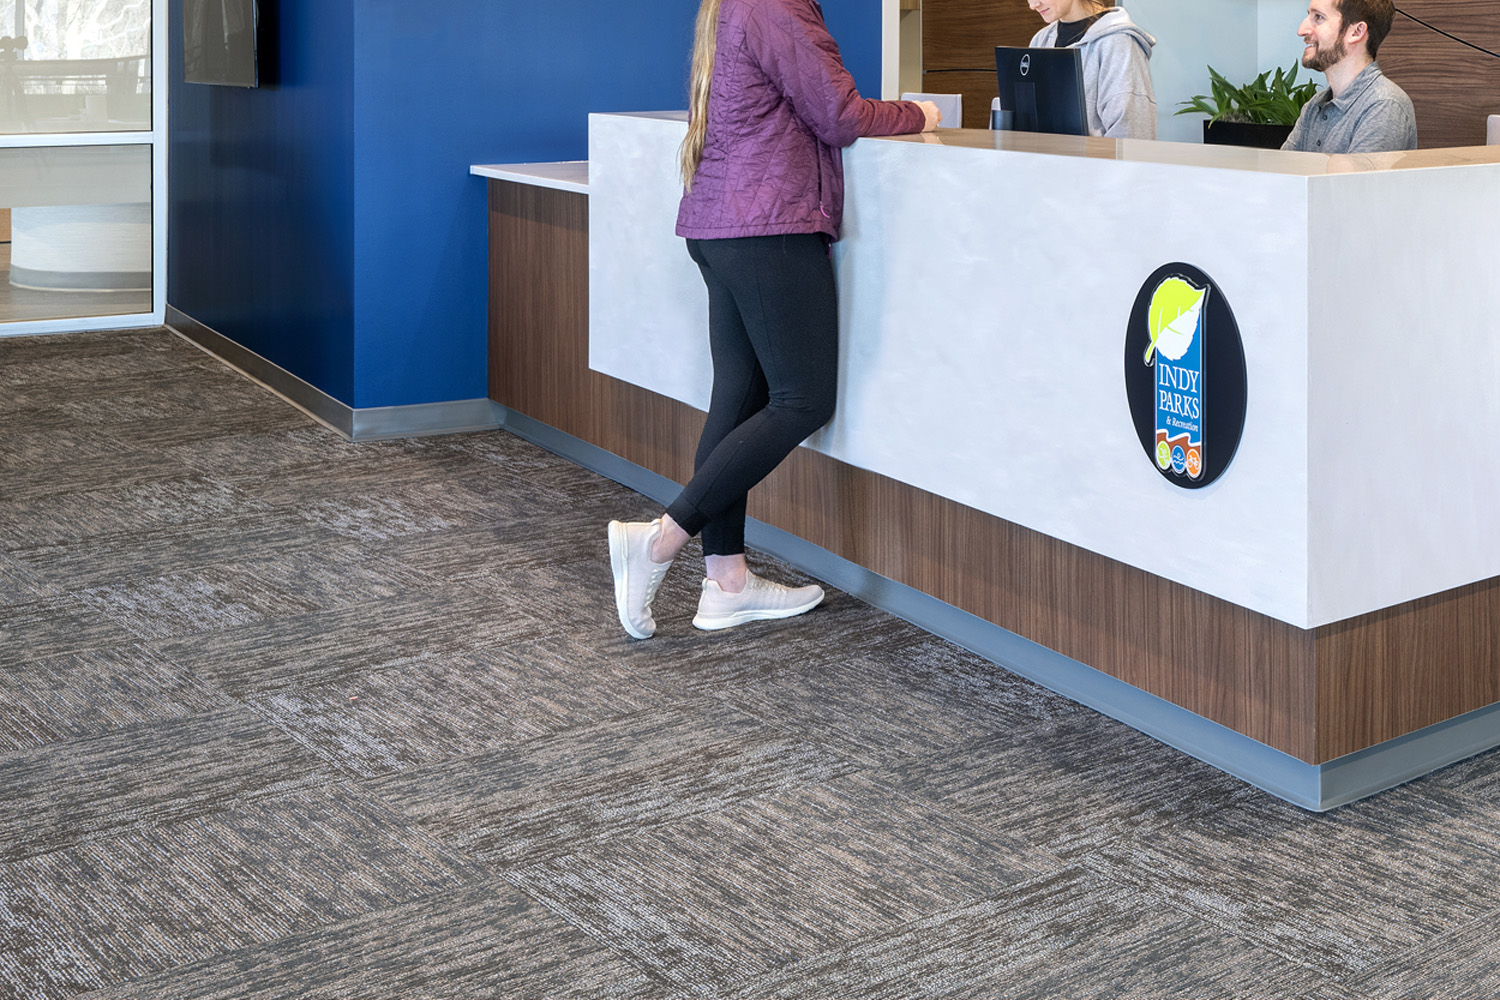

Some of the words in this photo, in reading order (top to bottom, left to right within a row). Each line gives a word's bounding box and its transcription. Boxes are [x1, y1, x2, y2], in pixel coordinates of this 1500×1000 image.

[1158, 363, 1200, 393] INDY
[1158, 389, 1200, 420] PARKS
[1165, 416, 1171, 425] &
[1172, 417, 1199, 432] Recreation
